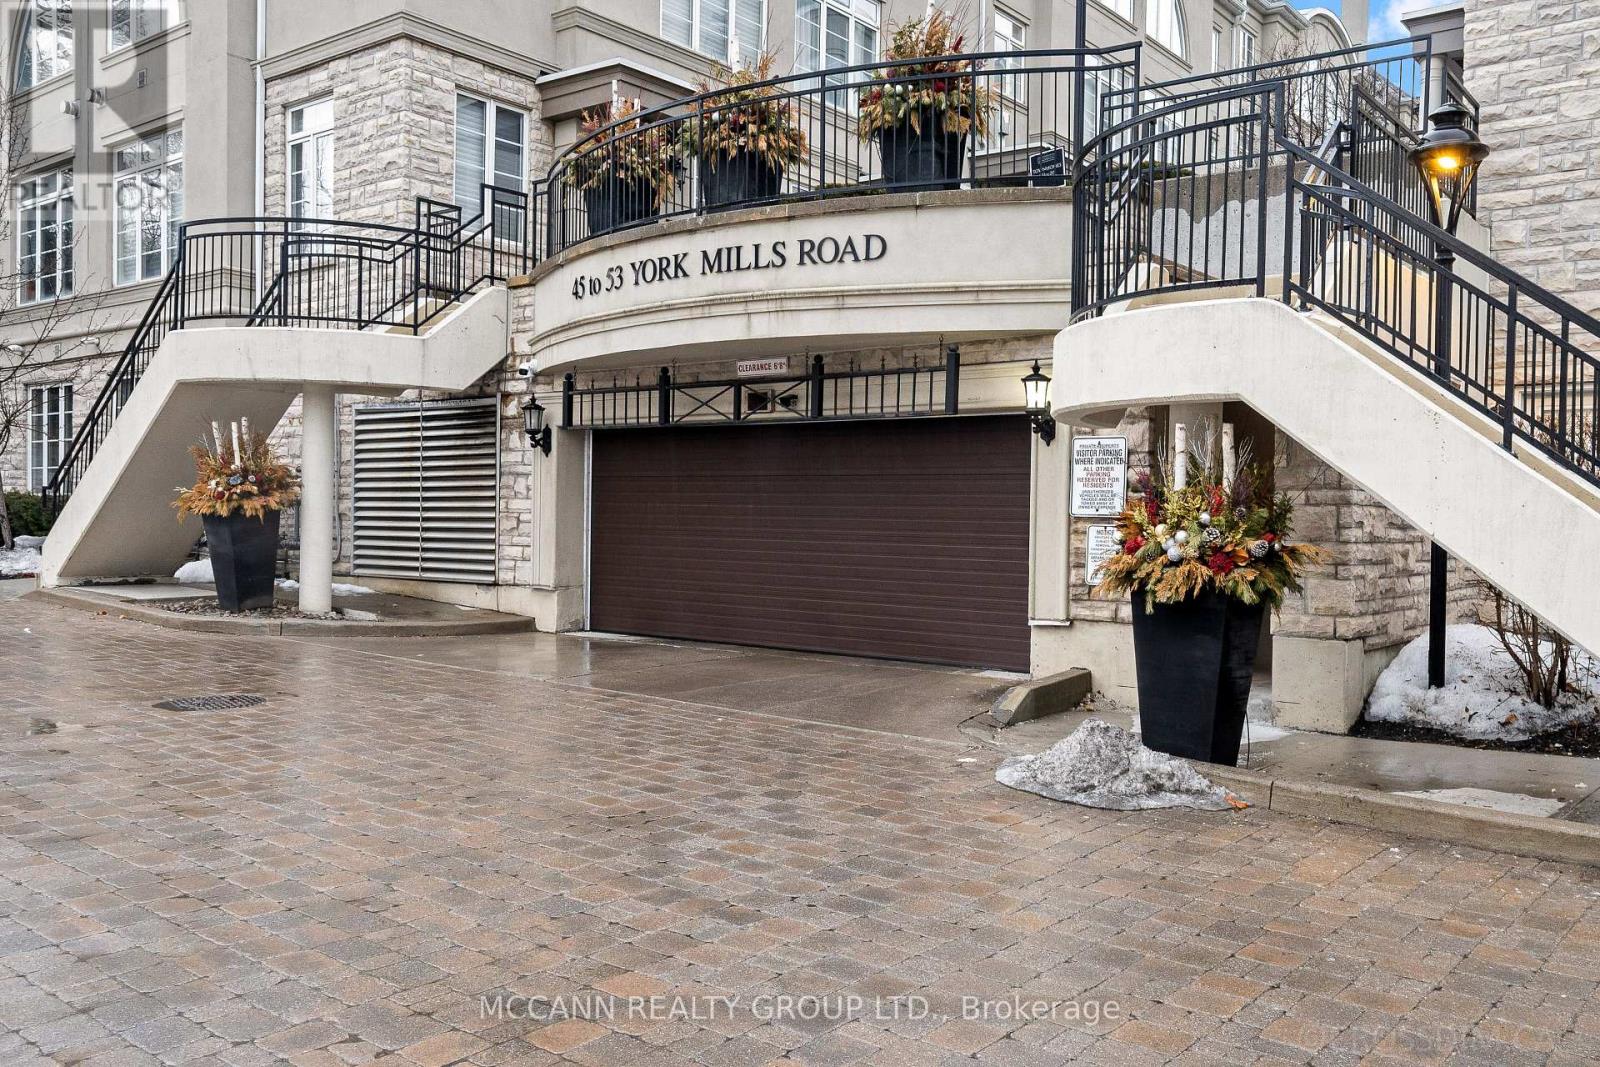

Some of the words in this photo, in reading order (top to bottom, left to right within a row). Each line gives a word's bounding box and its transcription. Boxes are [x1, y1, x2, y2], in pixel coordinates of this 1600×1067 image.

[571, 274, 586, 300] 45
[588, 277, 602, 296] to
[604, 264, 624, 293] 53
[630, 252, 690, 286] YORK
[699, 240, 787, 276] MILLS
[796, 233, 887, 266] ROAD
[738, 362, 772, 372] CLEARANCE
[1076, 449, 1098, 457] VISITOR
[1098, 449, 1123, 457] PARKING
[1075, 457, 1094, 465] WHERE
[1094, 457, 1124, 465] INDICATED
